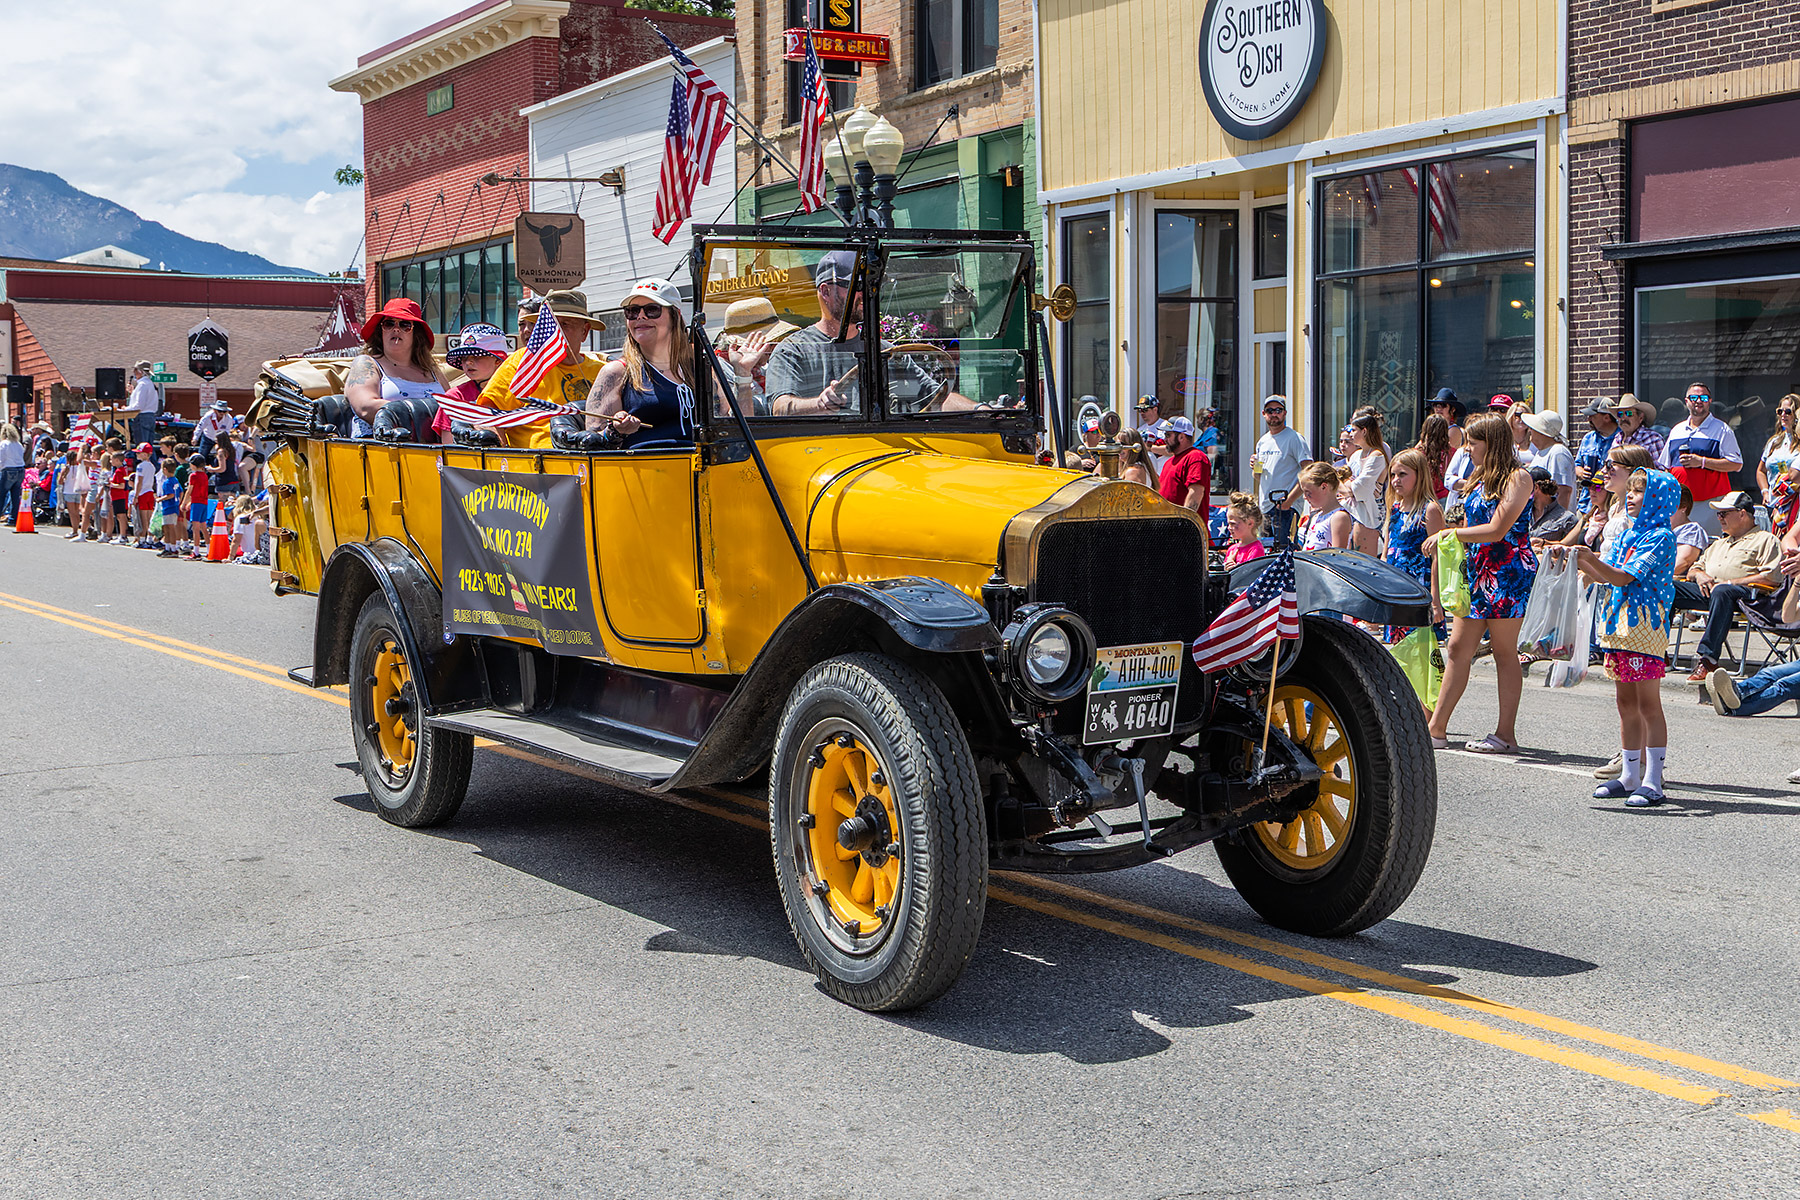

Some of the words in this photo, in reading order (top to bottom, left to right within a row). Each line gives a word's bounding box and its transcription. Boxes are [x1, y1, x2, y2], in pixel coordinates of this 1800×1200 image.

[1217, 0, 1301, 54] SOUTHERN
[834, 38, 845, 52] &
[847, 40, 886, 55] GRILL
[1237, 41, 1282, 88] DISH
[1228, 92, 1259, 112] KITCHEN
[1261, 103, 1267, 111] &
[1269, 82, 1291, 107] HOME
[706, 277, 740, 294] OSTER
[740, 276, 747, 289] &
[748, 268, 789, 288] LOGAN'S
[1175, 381, 1211, 391] OPEN
[461, 482, 496, 521] HAPPY
[498, 482, 550, 530] BIRTHDAY
[495, 528, 513, 557] NO.
[514, 530, 533, 559] 274
[532, 584, 578, 612] YEARS!
[1114, 646, 1161, 658] MONTANA
[1128, 693, 1161, 703] PIONEER
[1123, 701, 1170, 730] 4640
